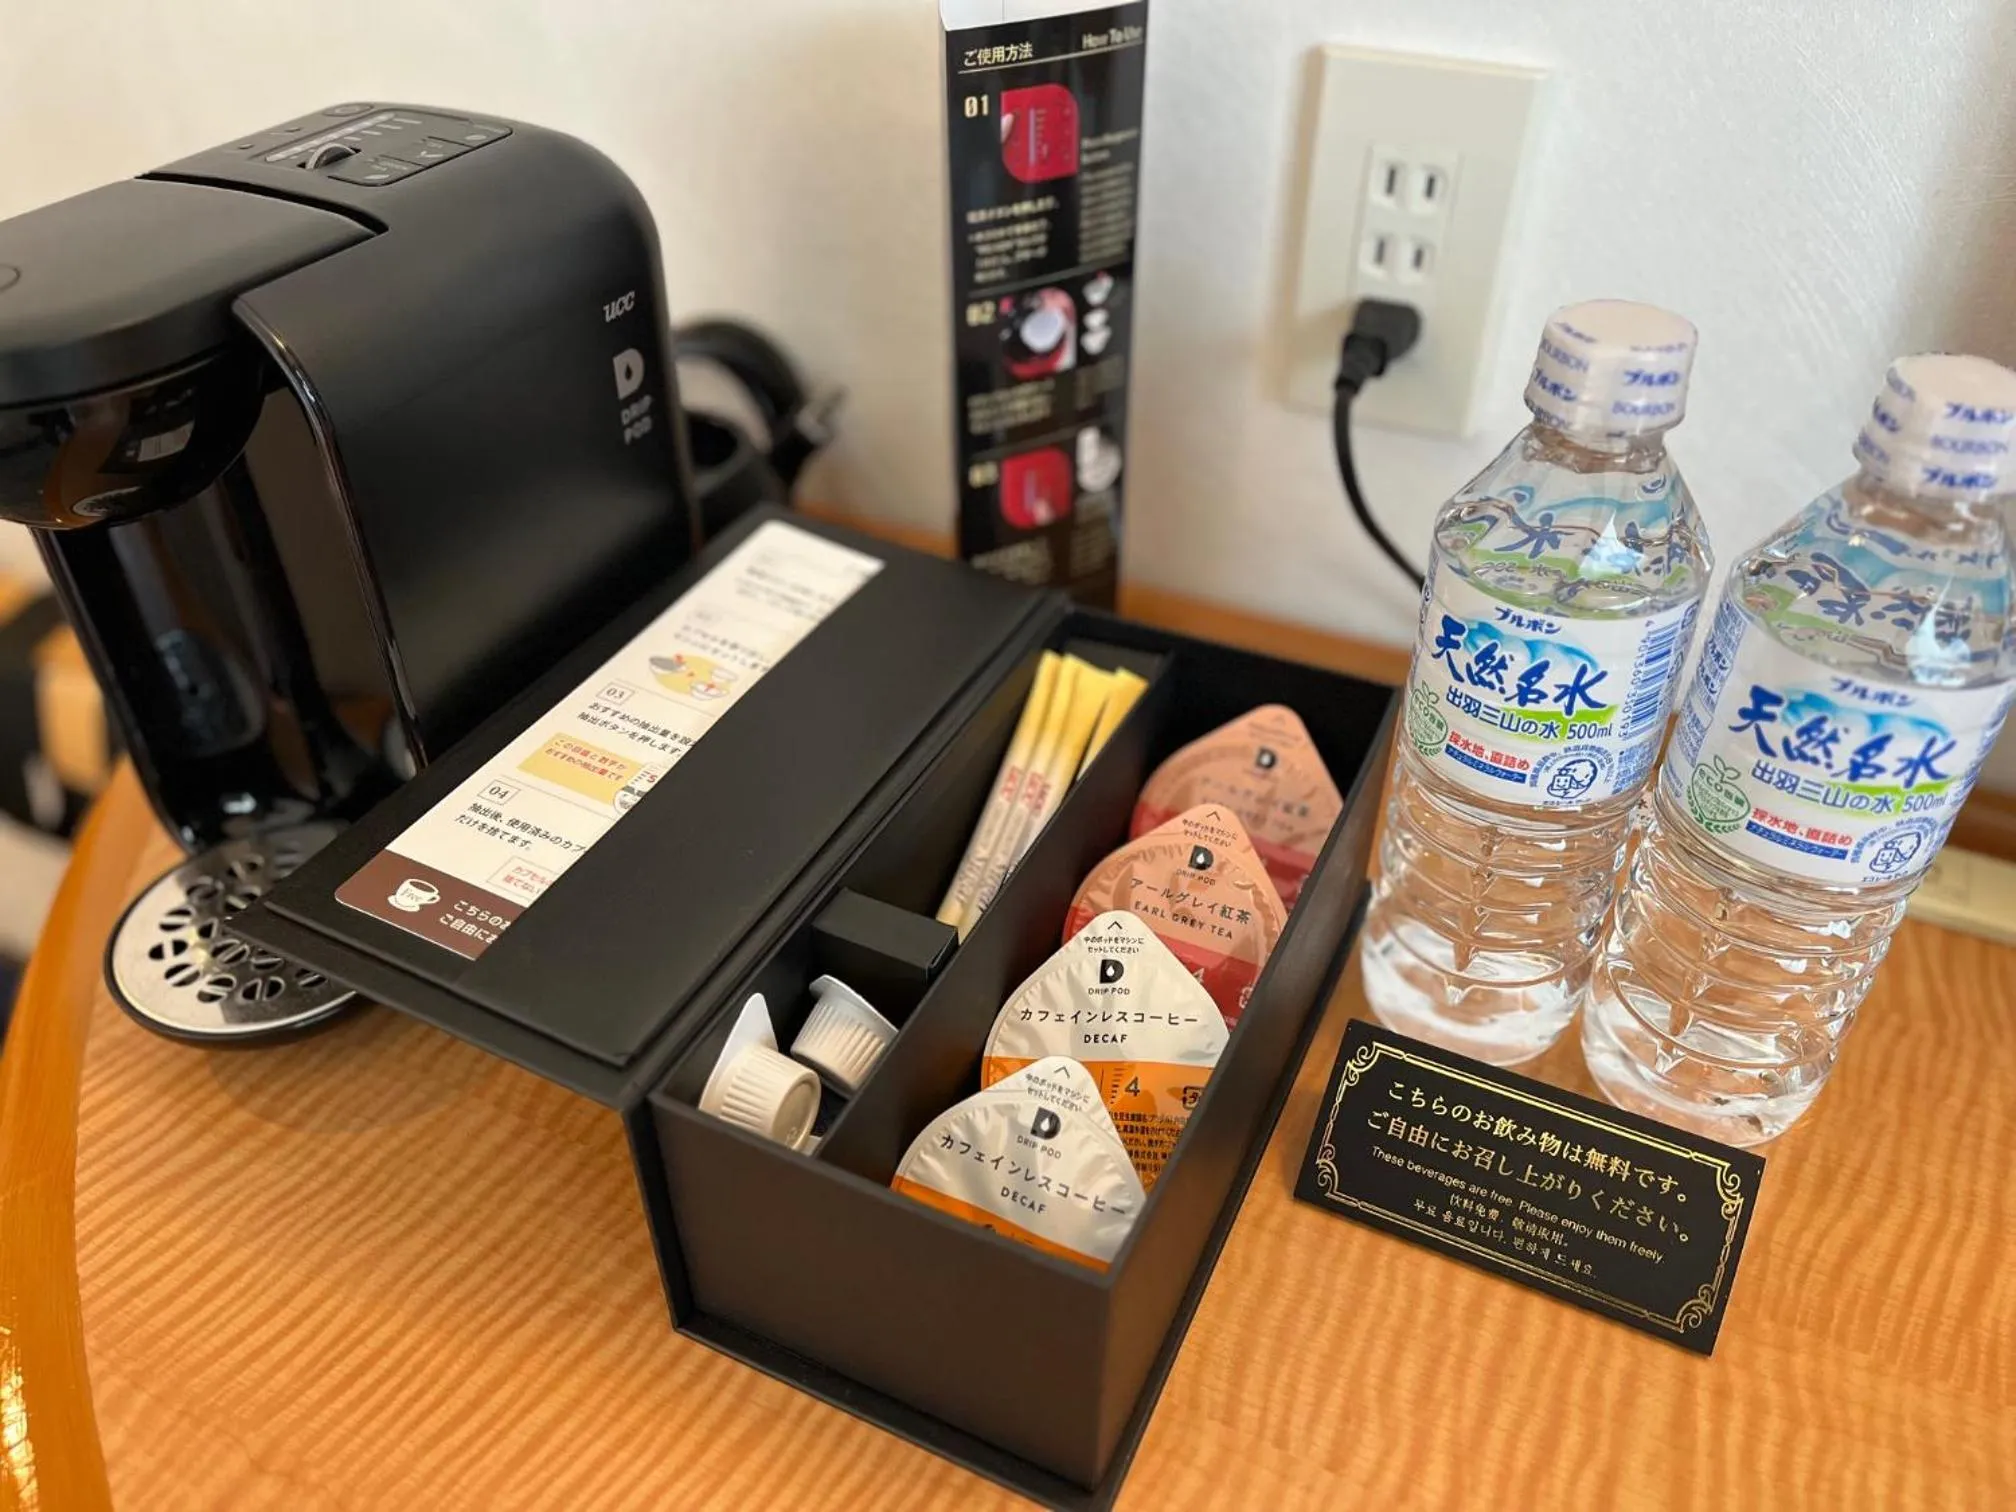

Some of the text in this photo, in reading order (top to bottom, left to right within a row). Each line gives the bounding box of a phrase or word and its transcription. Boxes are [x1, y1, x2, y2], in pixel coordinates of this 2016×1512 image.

[964, 42, 1033, 66] ご使用方法
[964, 95, 989, 118] 01
[1495, 606, 1562, 634] ブルボン
[1432, 614, 1609, 717] 天然名水
[606, 687, 625, 700] 03
[1831, 676, 1917, 708] ブルボン
[588, 702, 698, 748] おすすめの抽出量を設
[1446, 686, 1613, 741] 出羽三山の水 500ml
[1728, 684, 1957, 789] 天然名水
[489, 786, 509, 799] 04
[1751, 759, 1948, 814] 出羽三山の水 500ml
[1130, 878, 1252, 925] アールグレイ紅茶
[1134, 901, 1234, 940] EARL GREY TEA
[1087, 986, 1131, 996] DRIP POD
[1020, 1008, 1198, 1025] カフェインレスコーヒー
[1084, 1034, 1128, 1044] DECAF
[1125, 1076, 1140, 1097] 4
[1016, 1135, 1062, 1159] DRIP POD
[1389, 1081, 1687, 1203] こちらのお飲み物は無料です。
[941, 1134, 1126, 1215] カフェインレスコーヒー
[1367, 1111, 1689, 1242] ご自由にお召し上がりください。
[1001, 1186, 1047, 1214] DECAF
[1372, 1146, 1404, 1168] These
[1407, 1160, 1466, 1190] beverages
[1468, 1182, 1488, 1197] are
[1519, 1201, 1559, 1224] Please
[1561, 1218, 1594, 1238] enjoy
[1596, 1229, 1627, 1249] them
